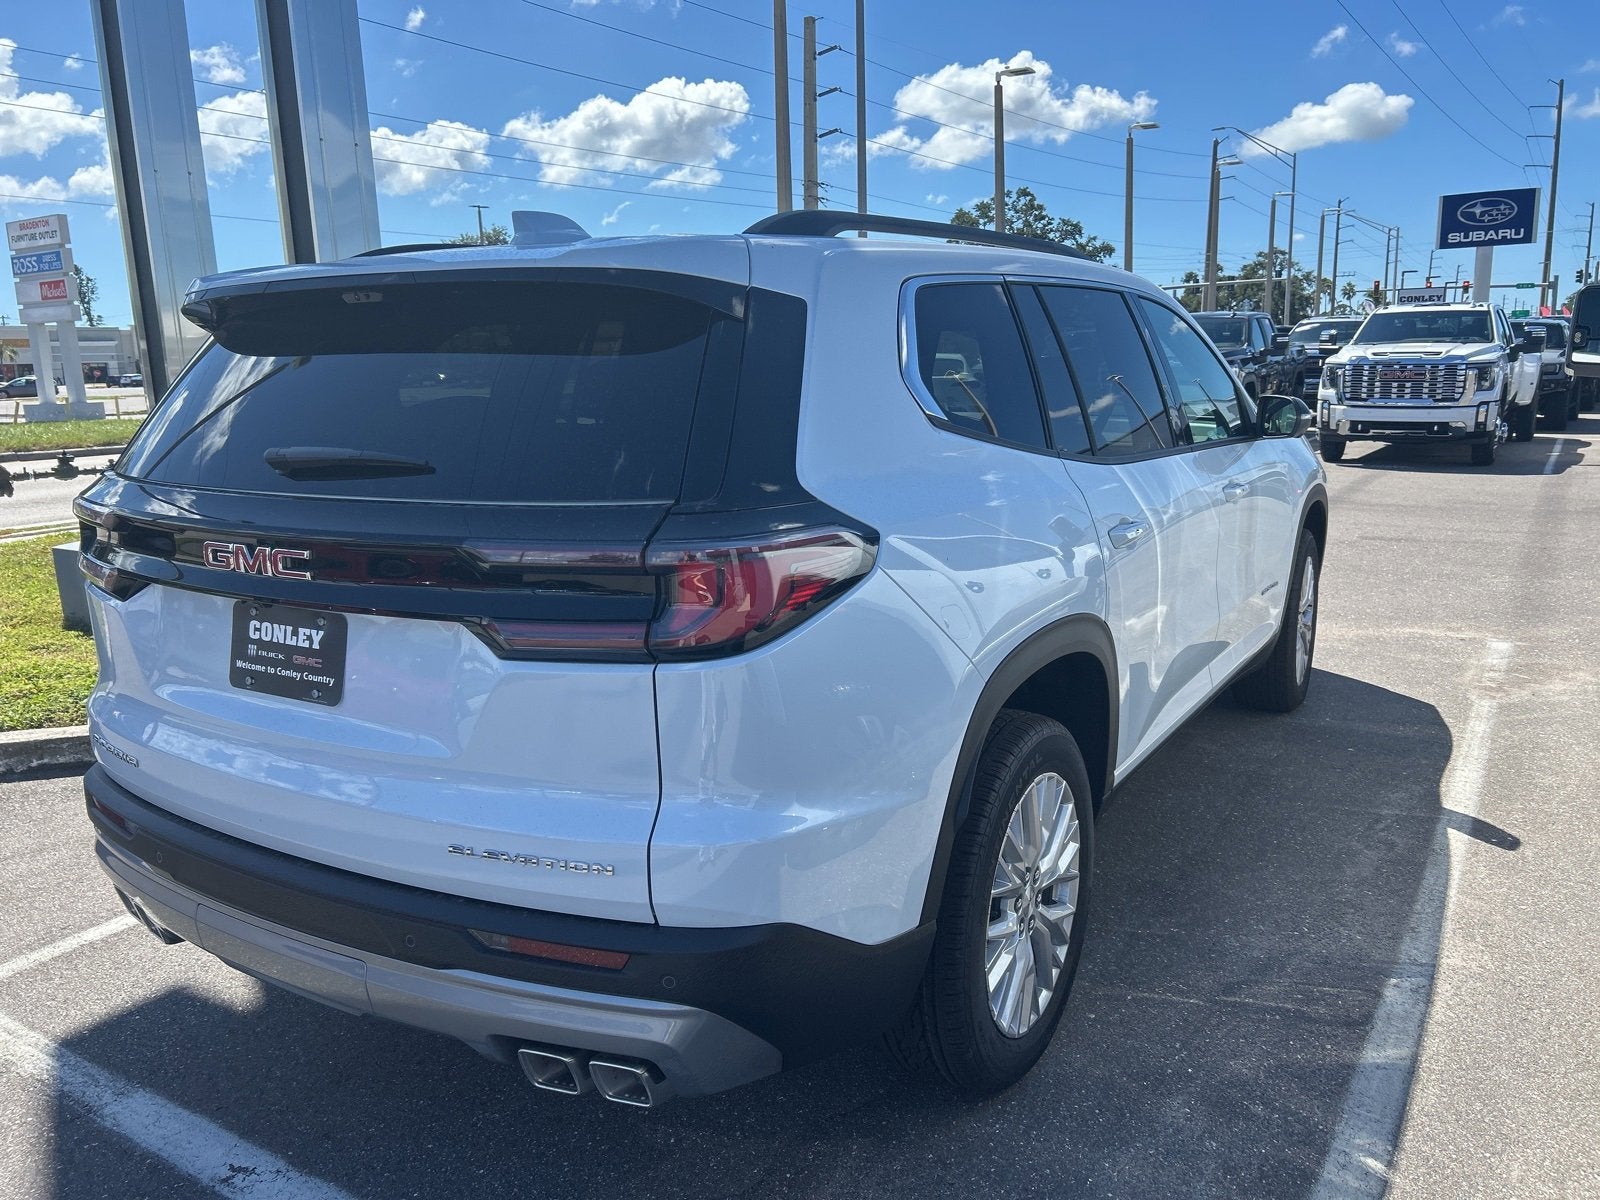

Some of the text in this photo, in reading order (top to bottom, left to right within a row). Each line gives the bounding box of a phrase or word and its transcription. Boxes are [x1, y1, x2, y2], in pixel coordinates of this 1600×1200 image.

[19, 219, 49, 231] BRADENTON
[11, 230, 58, 244] FURNITURE OUTLET
[1447, 228, 1525, 243] SUBARU
[13, 256, 39, 274] ROSS
[1399, 294, 1444, 303] CONLEY
[1380, 370, 1425, 379] GMC
[203, 540, 312, 581] GMC
[249, 619, 325, 650] CONLEY
[258, 650, 323, 668] BUICK GMC
[236, 659, 335, 687] Welcome to Conley Country
[448, 843, 615, 877] ELEVATION
